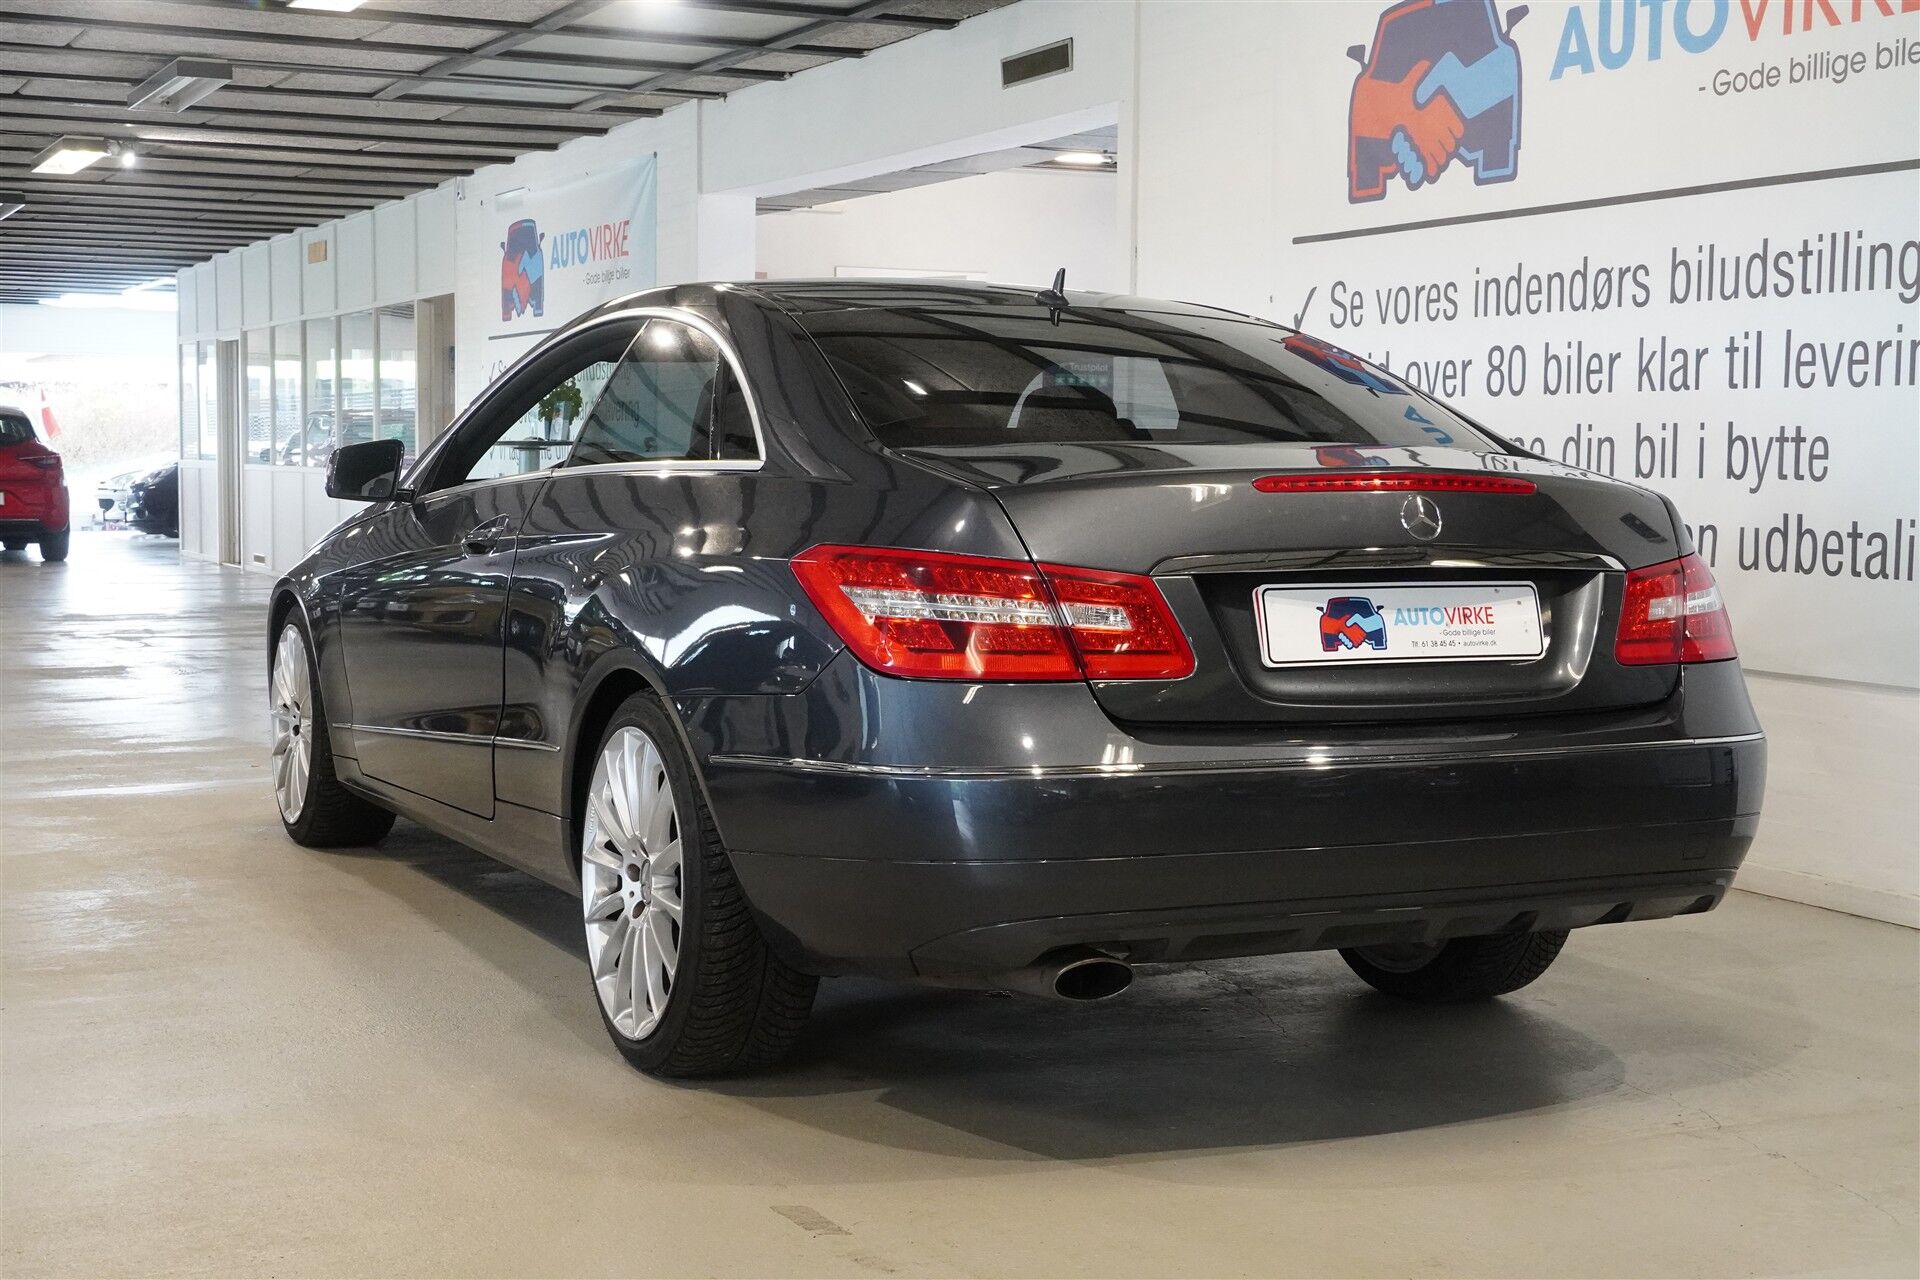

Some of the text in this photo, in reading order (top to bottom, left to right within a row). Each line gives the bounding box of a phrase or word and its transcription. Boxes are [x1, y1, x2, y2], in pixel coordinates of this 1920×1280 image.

[1549, 0, 1920, 81] AUTOV
[1713, 62, 1781, 96] Gode
[1789, 51, 1867, 84] billige
[1875, 37, 1920, 70] bile
[550, 219, 630, 270] AUTOVIRKE
[1329, 230, 1920, 328] Se vores indendørs biludstilling
[1405, 359, 1472, 398] over
[1486, 345, 1527, 397] 80
[1543, 340, 1622, 396] biler
[1637, 335, 1709, 392] klar
[1725, 330, 1762, 389] til
[1562, 423, 1615, 477] din
[1634, 422, 1678, 479] bil
[1698, 422, 1705, 479] i
[1726, 421, 1829, 494] bytte
[1738, 513, 1916, 582] udbetali
[1394, 606, 1495, 626] AUTOVIRKE
